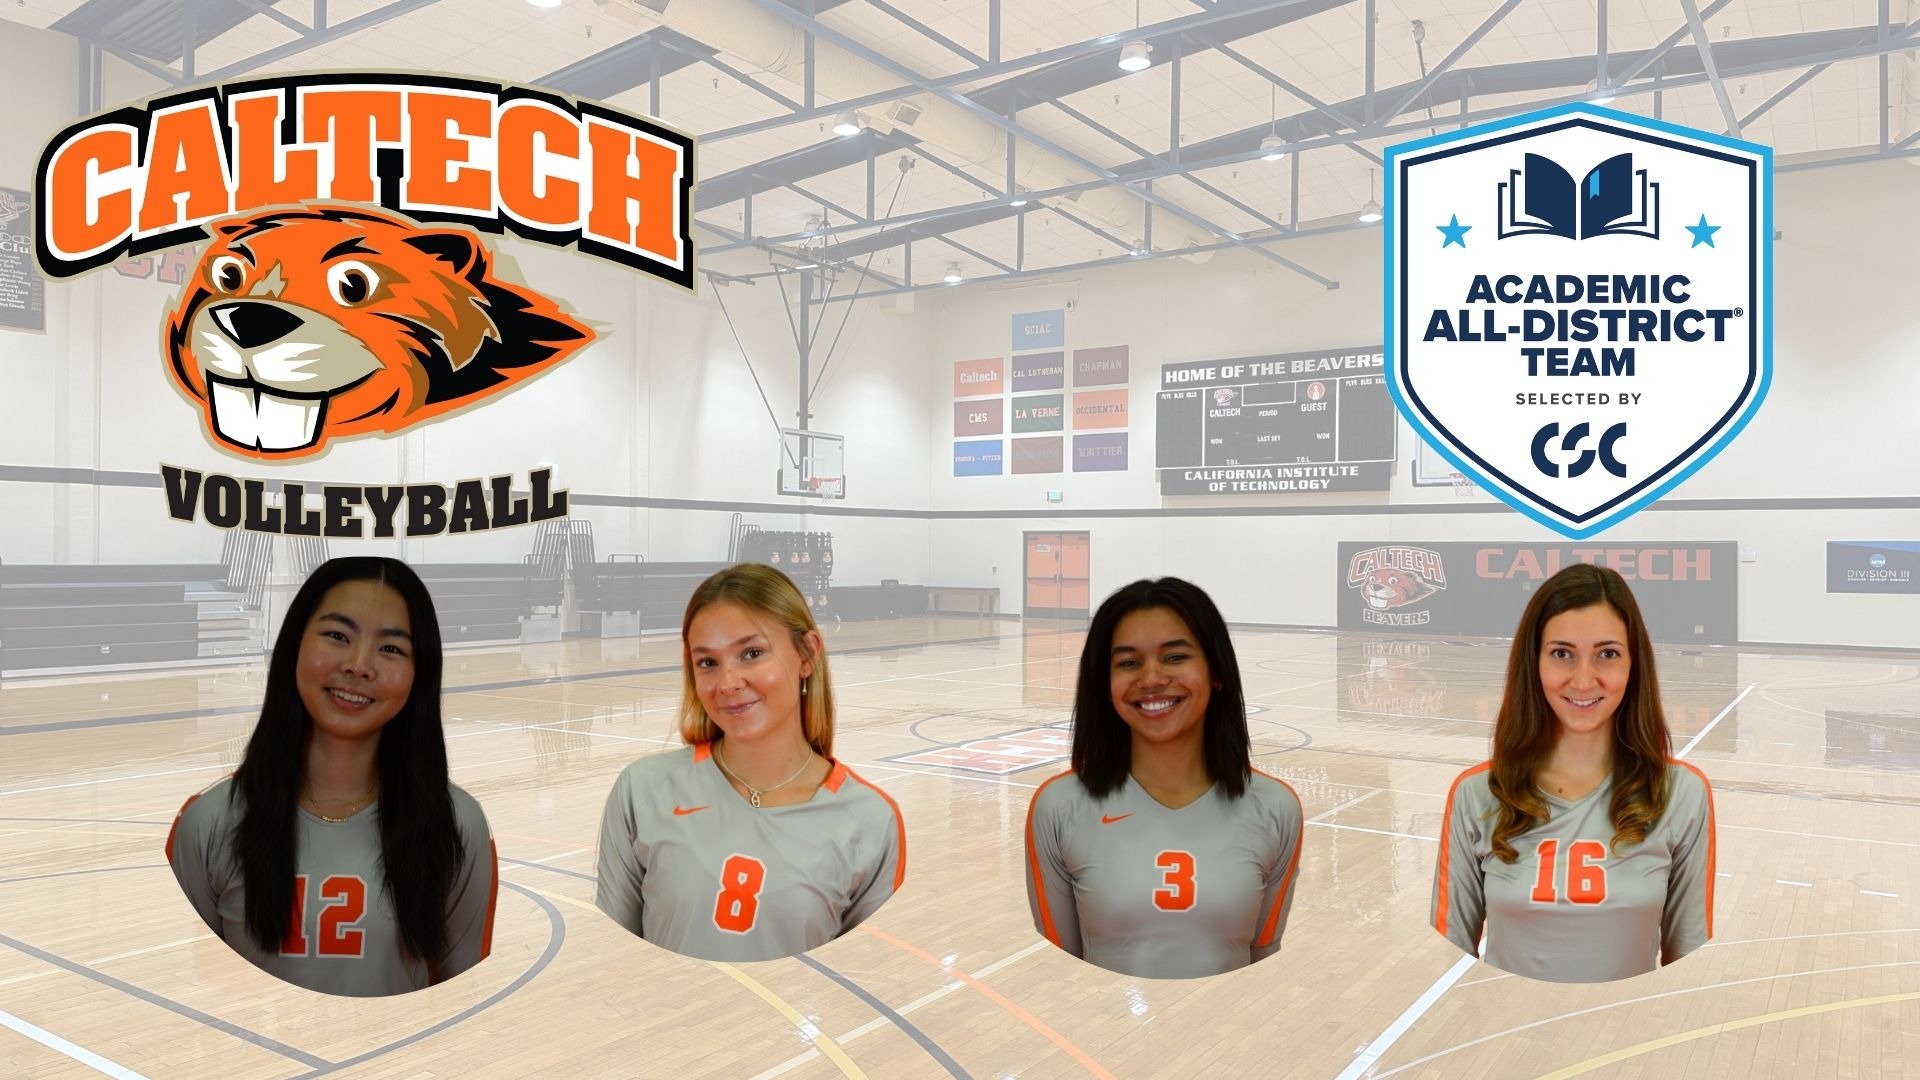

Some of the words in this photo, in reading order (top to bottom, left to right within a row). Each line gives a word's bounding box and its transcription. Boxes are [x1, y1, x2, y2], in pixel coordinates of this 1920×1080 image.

[0, 242, 32, 254] Clu
[1025, 324, 1052, 335] SCIAC
[1079, 360, 1122, 372] CHAPMAN
[1165, 366, 1217, 384] HOME
[1221, 365, 1244, 379] OF
[1249, 361, 1286, 377] THE
[1291, 353, 1384, 374] BEAVERS
[960, 370, 997, 384] Caltech
[1013, 370, 1025, 378] CAL
[1028, 367, 1063, 377] LUTHERAN
[1016, 410, 1027, 419] LA
[1032, 407, 1060, 418] VERNE
[1075, 404, 1125, 416] OCCIDENTAL
[1209, 408, 1241, 418] CALTECH
[1301, 402, 1328, 412] GUEST
[969, 412, 988, 424] CMS
[1316, 432, 1330, 440] WON
[1078, 446, 1123, 458] WHITTIER
[1184, 469, 1273, 481] CALIFORNIA
[1277, 466, 1359, 478] INSTITUTE
[1209, 481, 1227, 492] OF
[1231, 479, 1331, 491] TECHNOLOGY
[1349, 548, 1444, 583] CALTECH
[1847, 569, 1897, 578] DIVISION
[1901, 569, 1910, 578] III
[1363, 608, 1429, 625] BEAVERS
[1529, 838, 1608, 907] 16
[1152, 848, 1198, 912] 3
[712, 852, 767, 935] 8
[280, 873, 368, 959] 12
